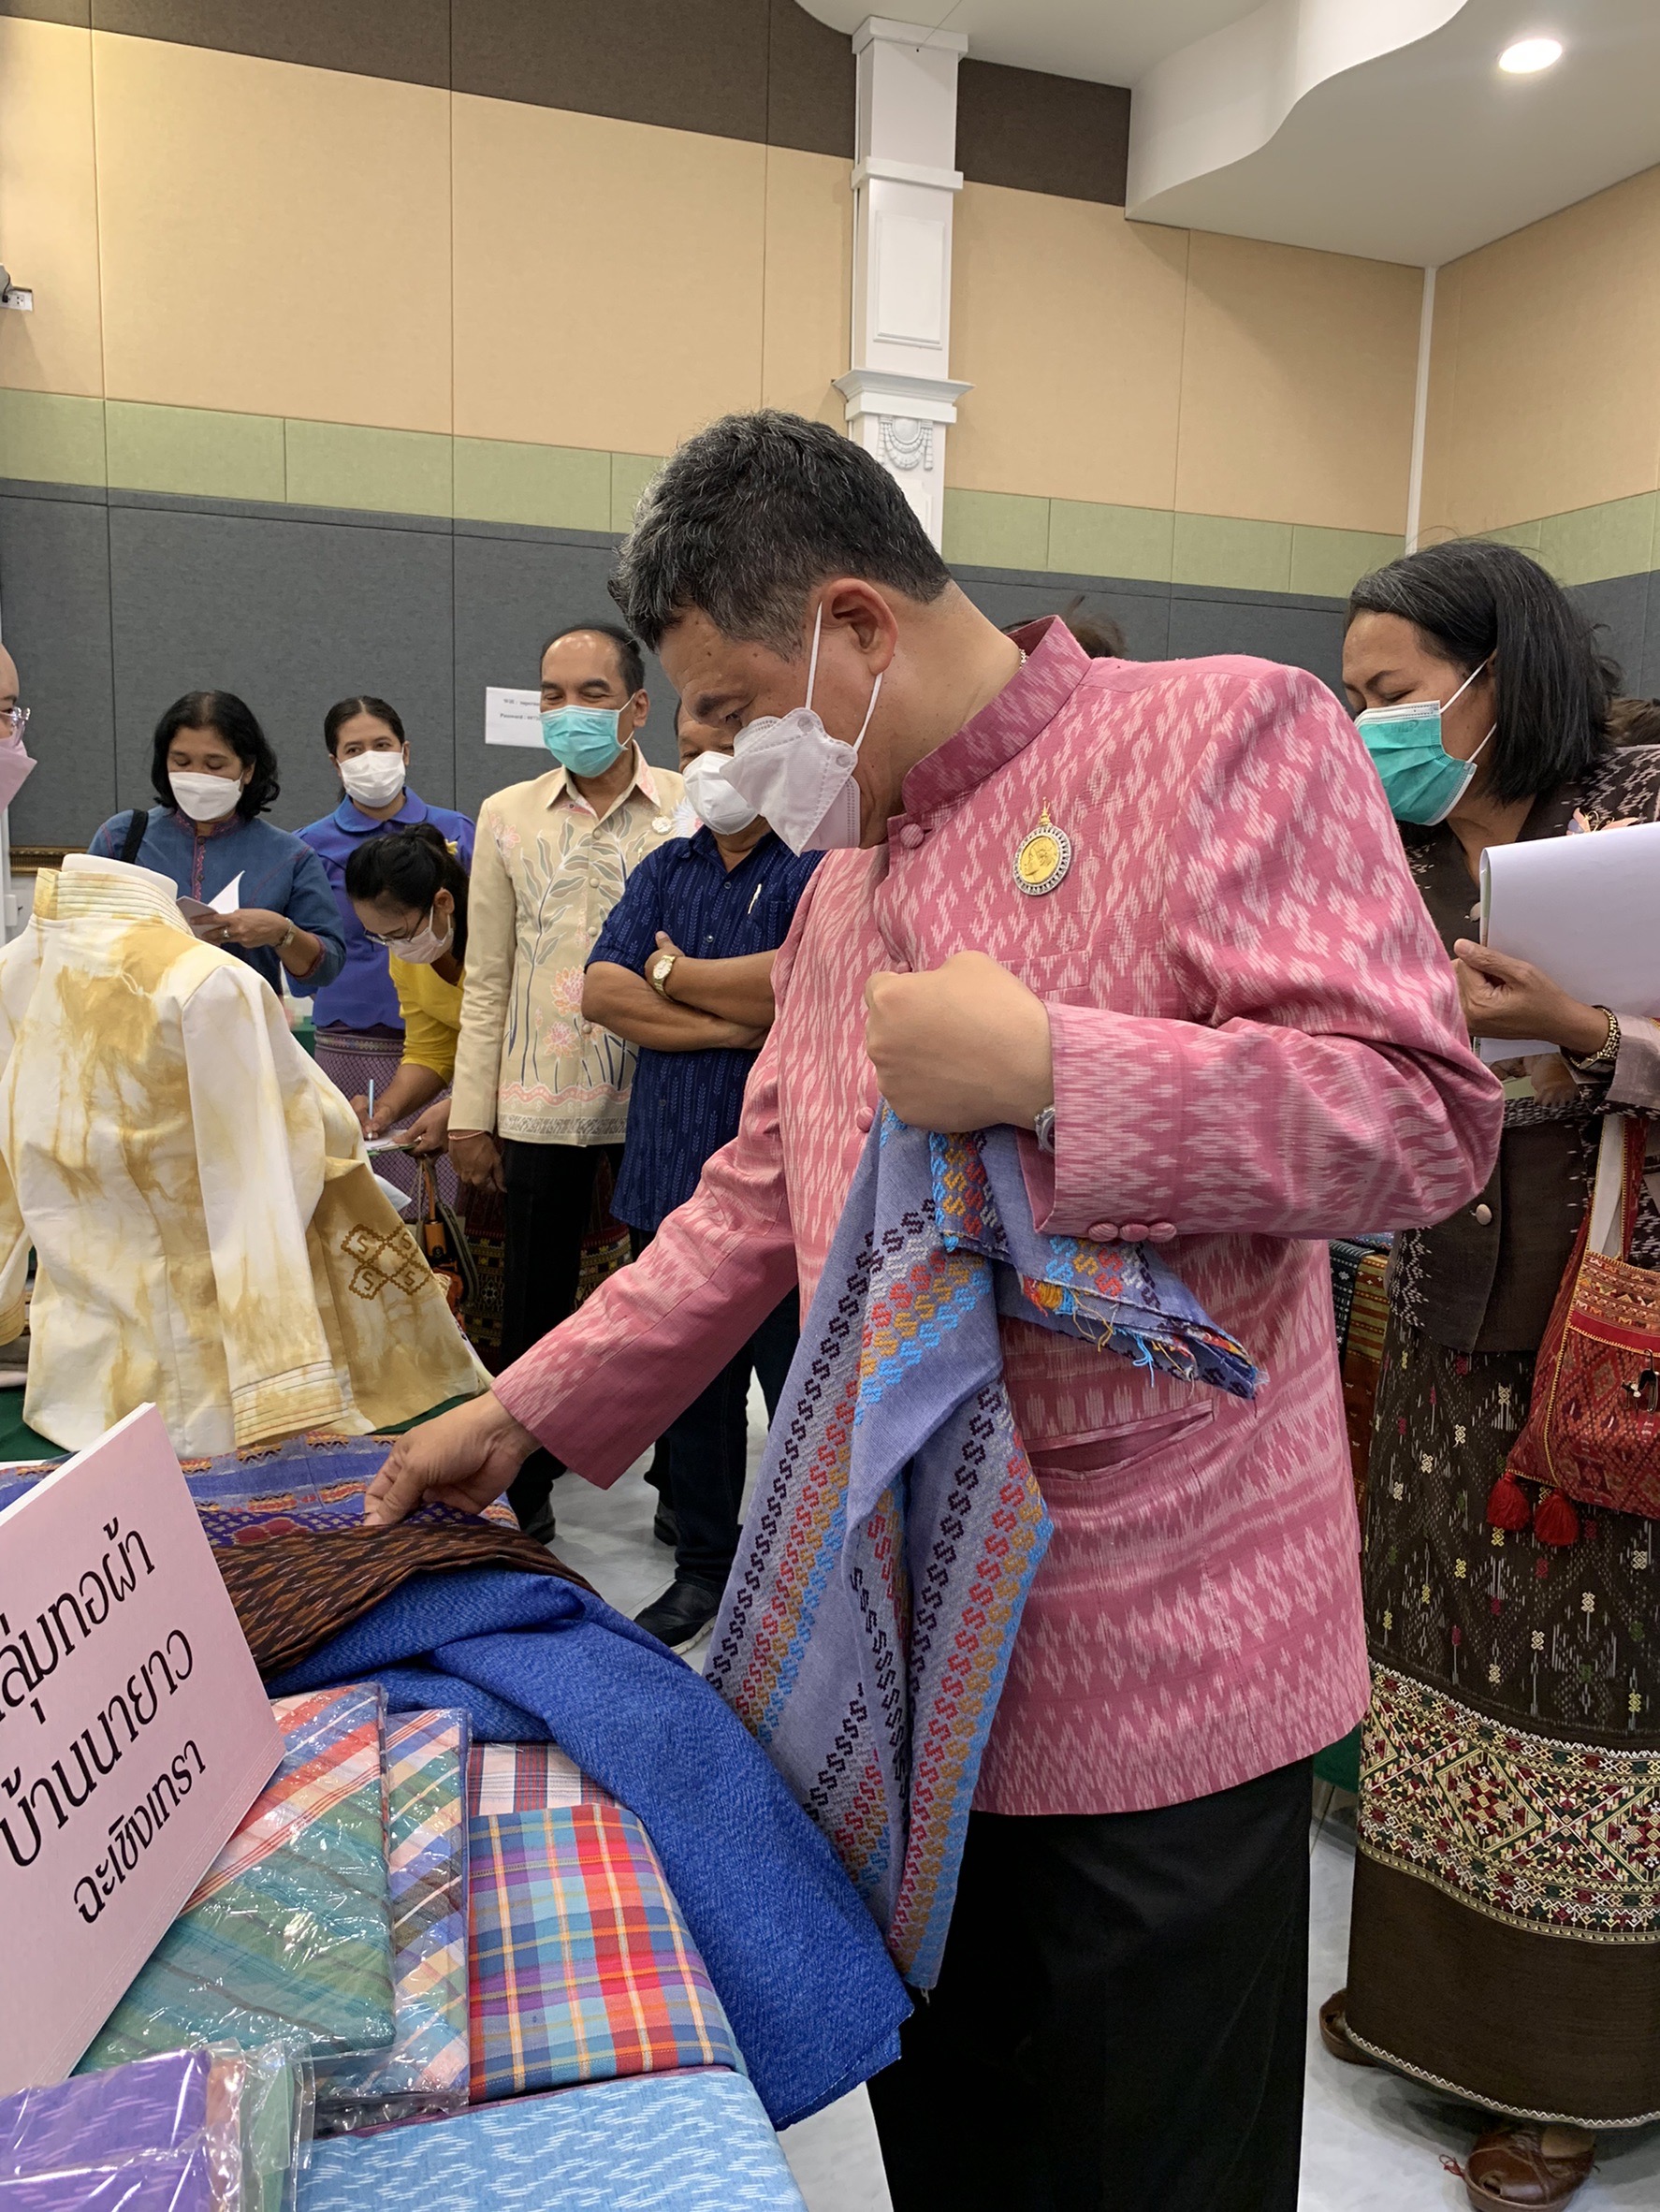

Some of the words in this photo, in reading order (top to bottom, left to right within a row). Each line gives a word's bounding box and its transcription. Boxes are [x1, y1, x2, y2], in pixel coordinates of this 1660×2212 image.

[0, 1517, 155, 1724] ลุ่มทอผ้า
[0, 1629, 193, 1867] บ้านนายาว
[74, 1739, 207, 1924] ฉะเชิงเทรา
